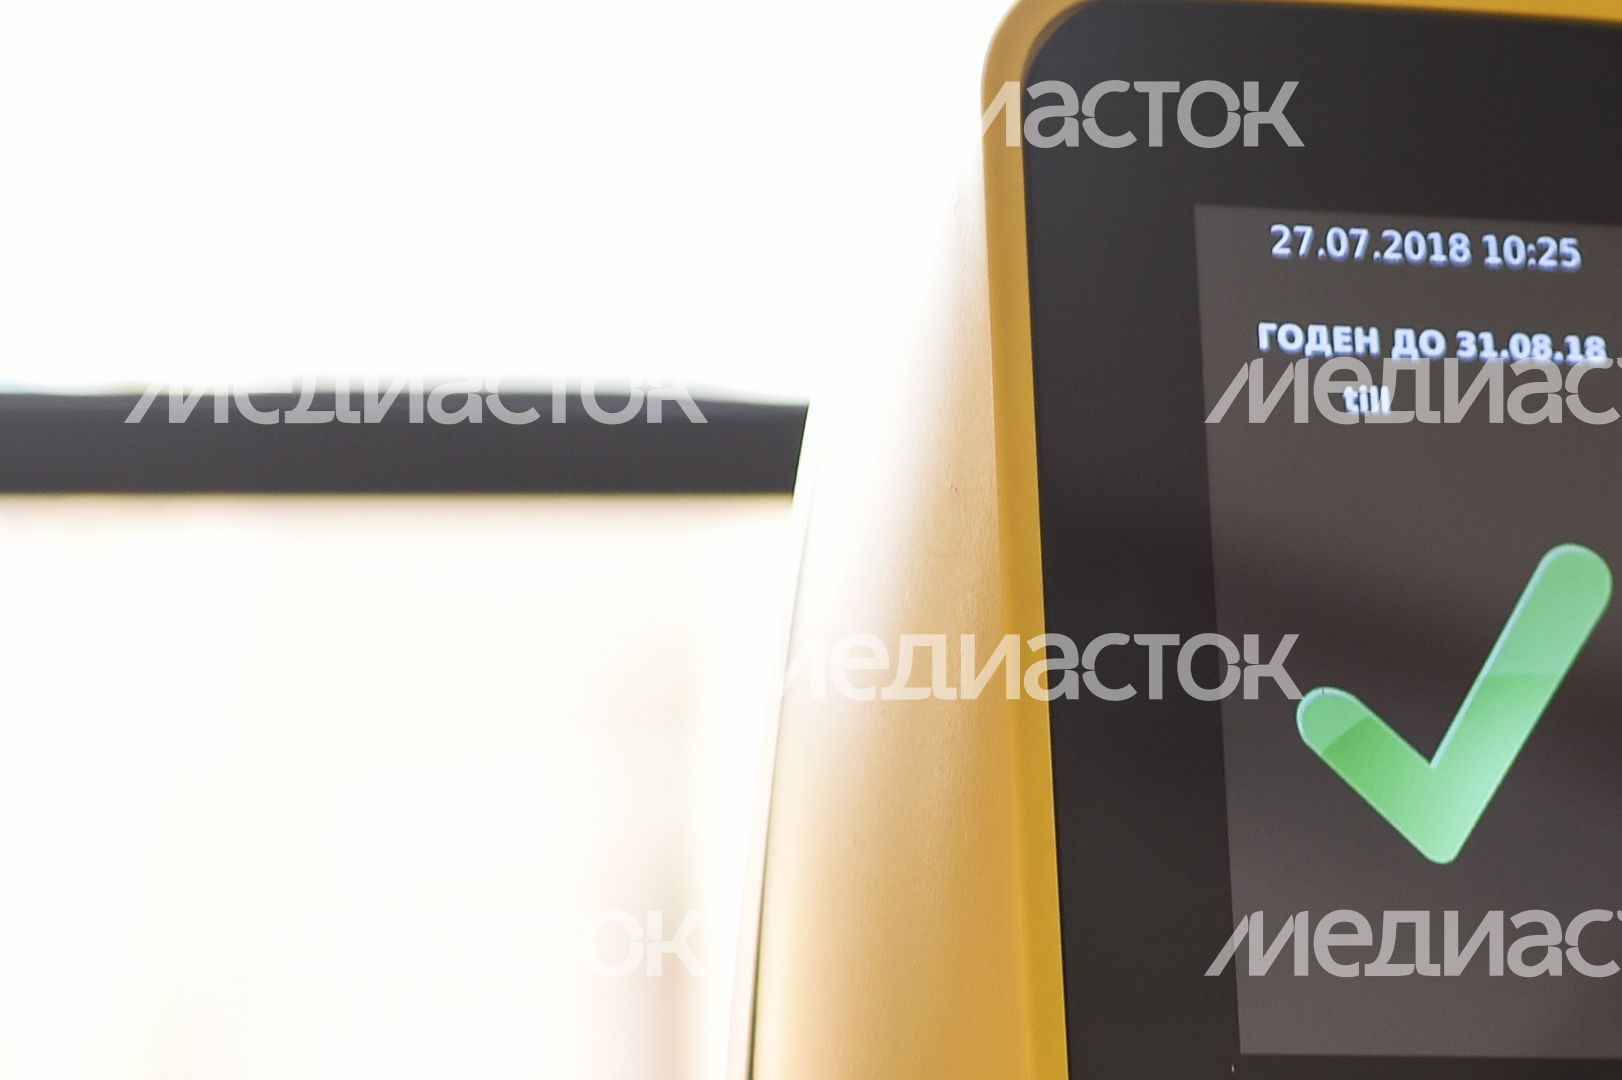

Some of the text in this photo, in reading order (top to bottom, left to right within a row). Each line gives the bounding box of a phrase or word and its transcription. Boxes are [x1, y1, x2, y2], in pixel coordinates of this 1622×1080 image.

[1270, 223, 1583, 272] 27.07.2018 10:25
[1257, 321, 1608, 366] ГОДЕН ДО 31.08.18
[1342, 383, 1393, 416] till
